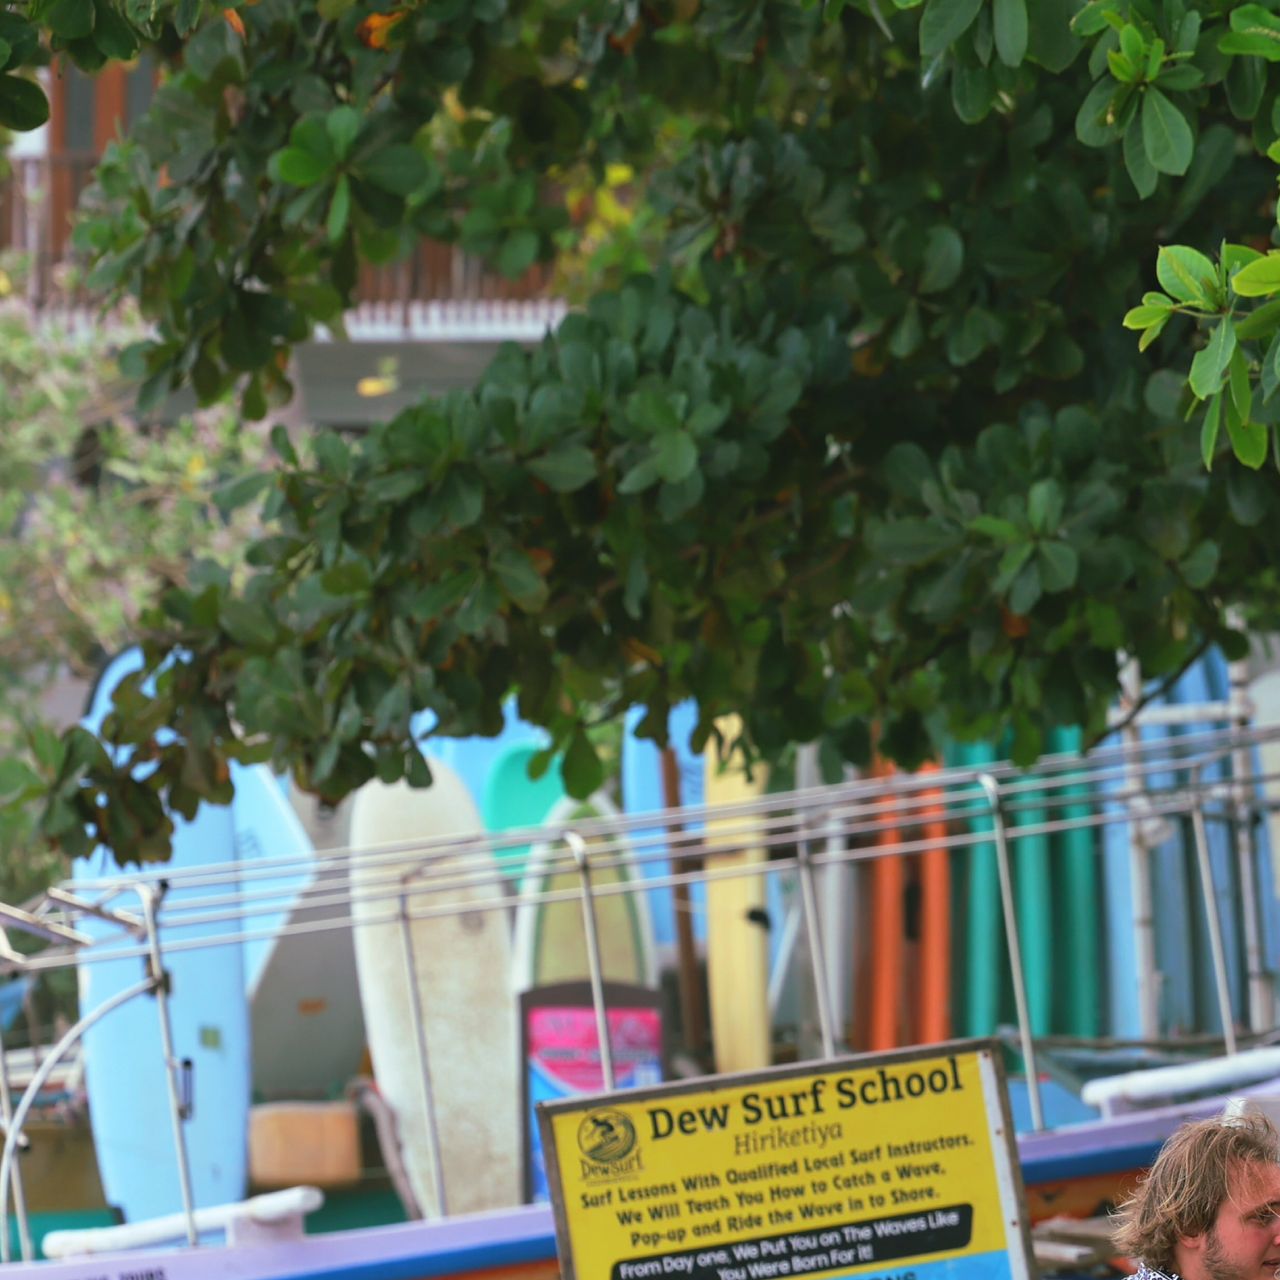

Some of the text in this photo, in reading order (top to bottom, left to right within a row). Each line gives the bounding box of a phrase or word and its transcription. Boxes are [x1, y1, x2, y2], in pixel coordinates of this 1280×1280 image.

[646, 1055, 963, 1141] Dew Surf School
[733, 1120, 844, 1156] Hiriketiya
[580, 1189, 612, 1209] Surf
[618, 1182, 677, 1203] Lessons
[681, 1173, 721, 1192] With
[725, 1160, 799, 1185] Qualified
[803, 1152, 845, 1173] Local
[849, 1145, 881, 1165] Surf
[615, 1210, 643, 1226] We
[647, 1202, 681, 1221] Will
[685, 1195, 731, 1215] Teach
[735, 1191, 764, 1208] You
[769, 1185, 806, 1203] How
[810, 1180, 828, 1195] to
[832, 1171, 876, 1191] Catch
[880, 1170, 891, 1183] a
[630, 1227, 687, 1248] Pop-up
[691, 1219, 722, 1238] and
[726, 1213, 763, 1232] Ride
[767, 1209, 794, 1225] the
[797, 1201, 843, 1220] Wave
[847, 1197, 864, 1211] in
[868, 1194, 886, 1208] to
